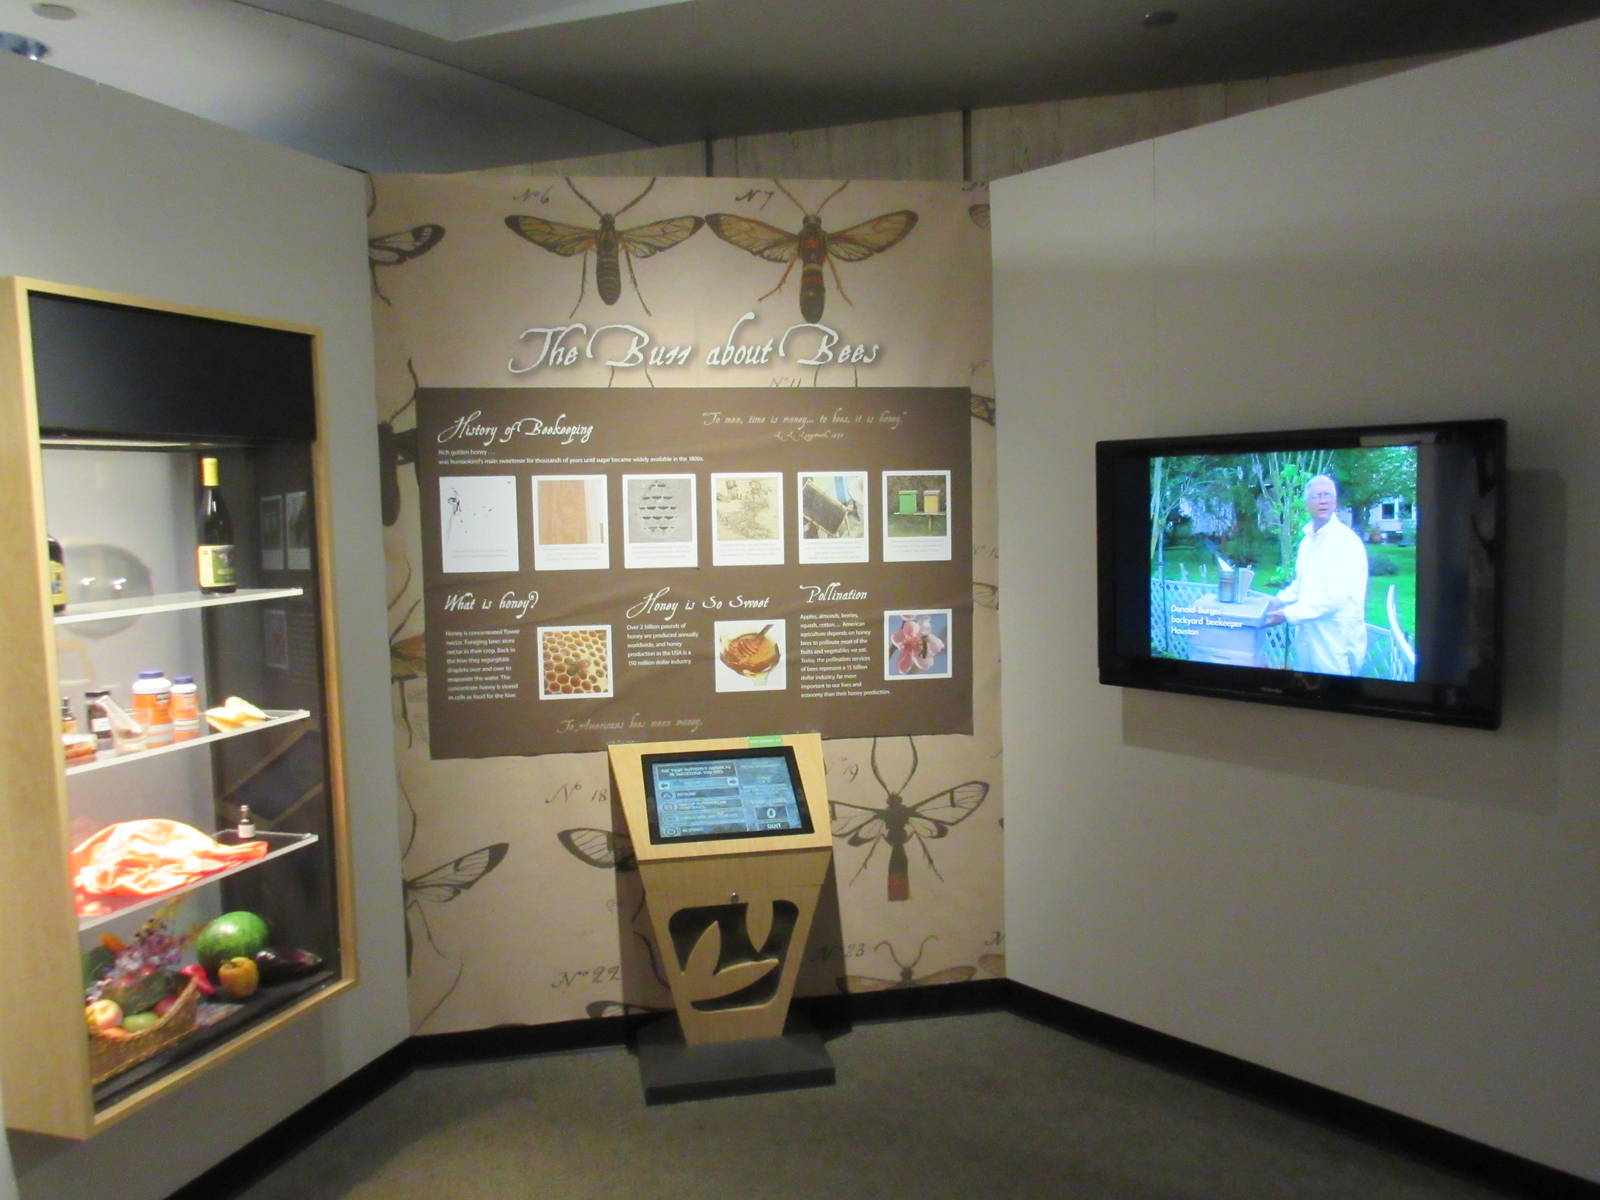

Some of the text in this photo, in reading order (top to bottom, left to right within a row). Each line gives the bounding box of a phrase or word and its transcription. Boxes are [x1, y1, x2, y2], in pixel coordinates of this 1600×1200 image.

[507, 311, 880, 373] The Buzz about Bees
[770, 415, 779, 424] is
[819, 413, 827, 424] to
[855, 413, 862, 423] it
[867, 414, 874, 423] is
[437, 410, 594, 447] History of Beekeeping
[470, 449, 487, 457] honey
[633, 455, 649, 463] widely
[650, 455, 672, 463] available
[799, 582, 868, 603] Pollination
[444, 590, 539, 619] What is honey?
[626, 587, 770, 621] Honey is So Sweet
[660, 623, 679, 631] pounds
[1171, 626, 1200, 636] Houston
[678, 631, 698, 639] annually
[855, 629, 871, 637] honey
[819, 639, 839, 647] pollinate
[766, 807, 776, 819] 0
